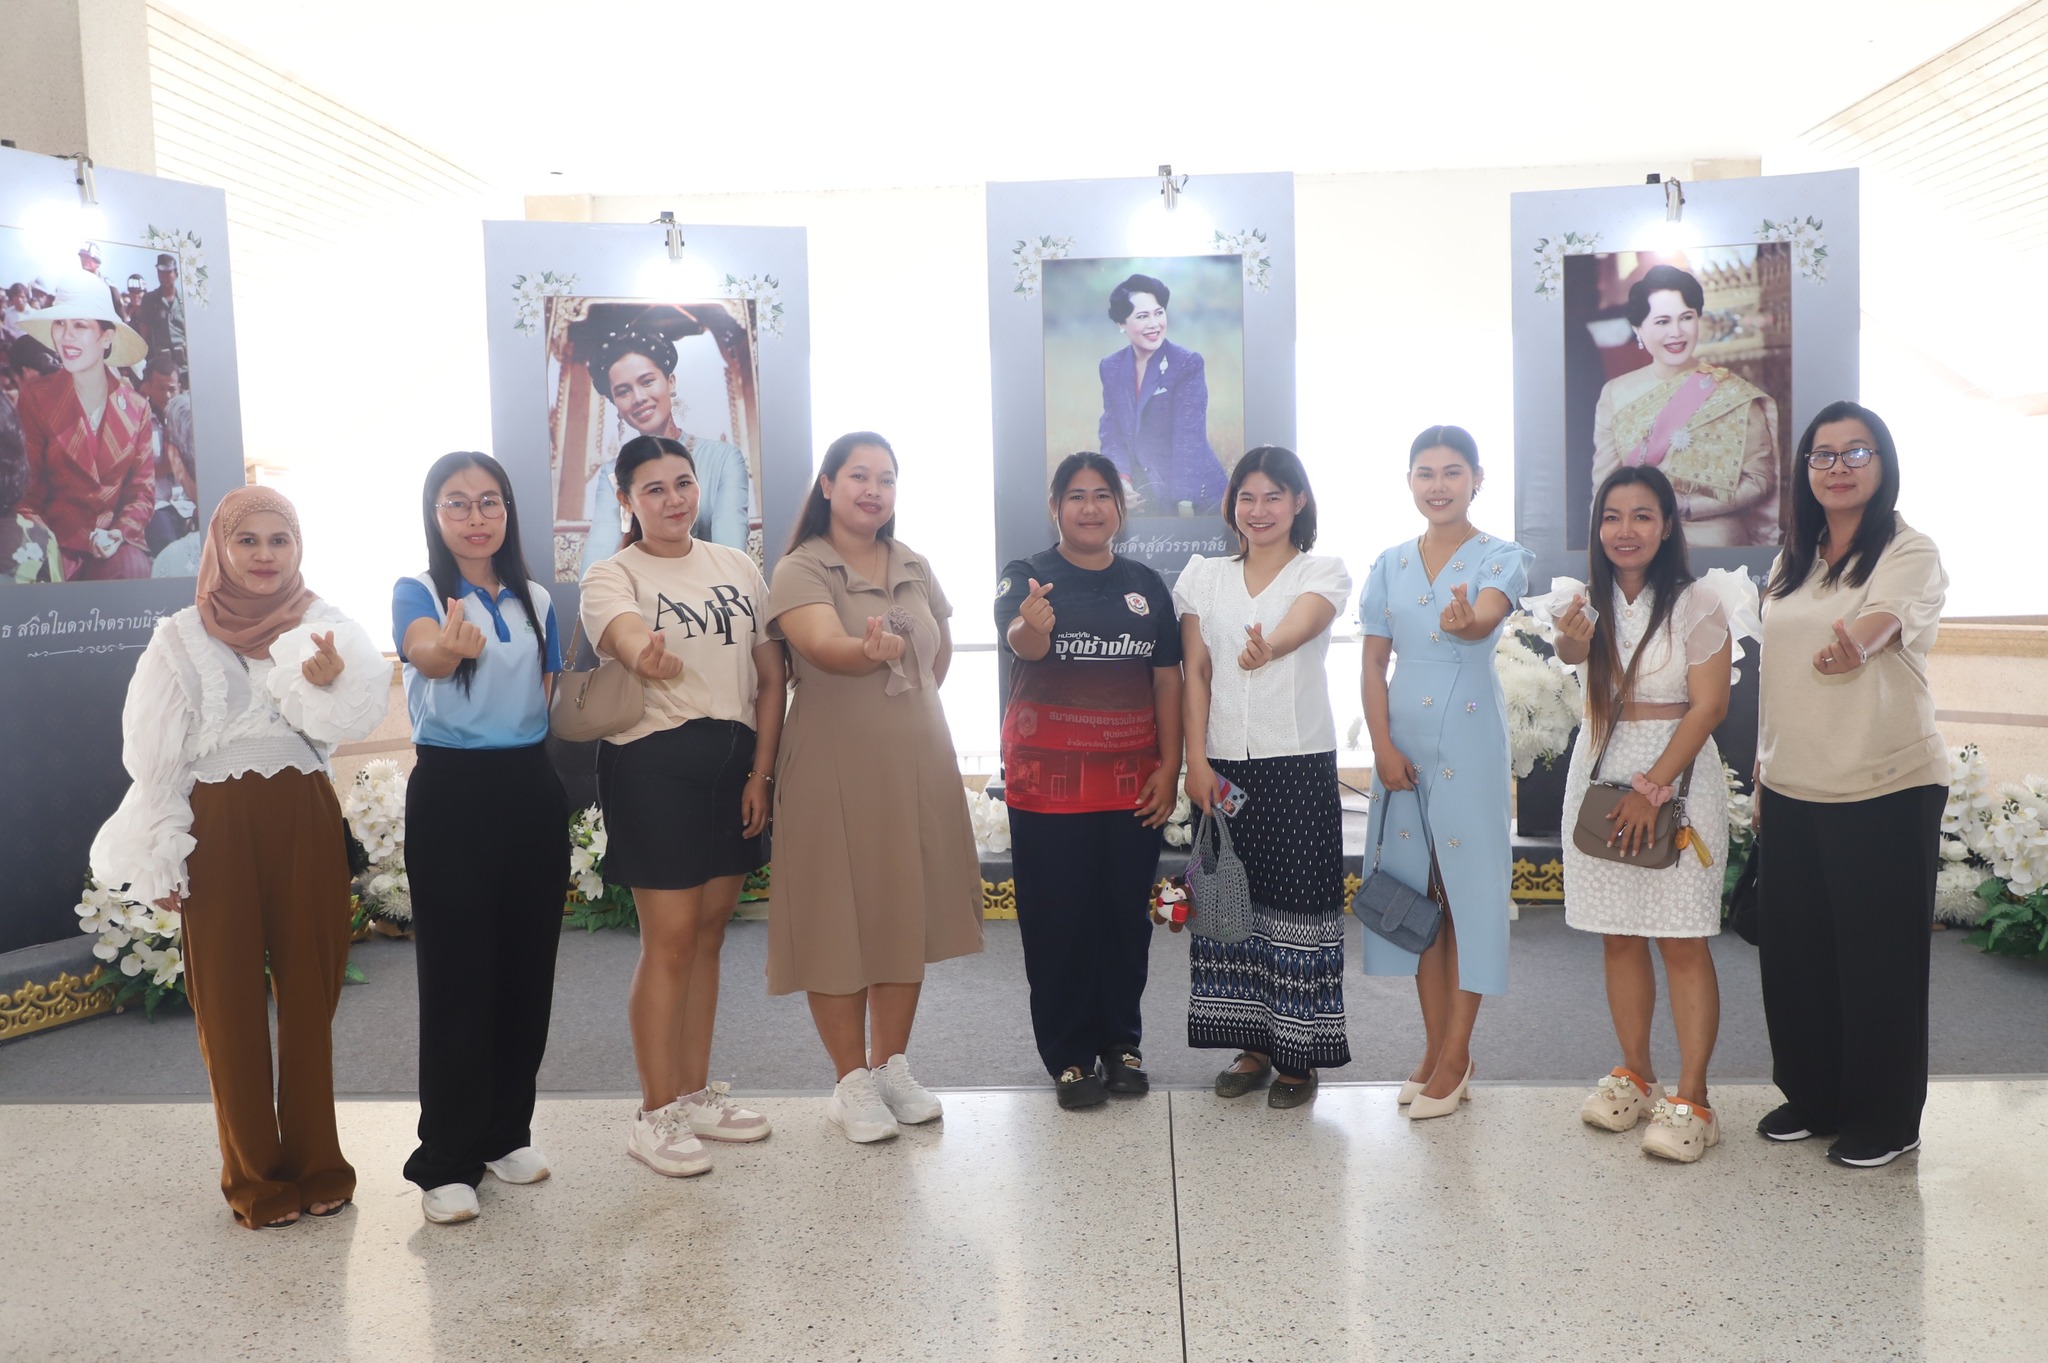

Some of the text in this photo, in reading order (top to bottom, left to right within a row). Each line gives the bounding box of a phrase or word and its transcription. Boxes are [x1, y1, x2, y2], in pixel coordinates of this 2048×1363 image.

[1112, 533, 1227, 559] เสด็จสู่สวรรคาลัย
[1, 606, 167, 639] ธ สถิตในดวงใจตราบนิรั
[1056, 633, 1155, 660] จุดช้างใหญ่
